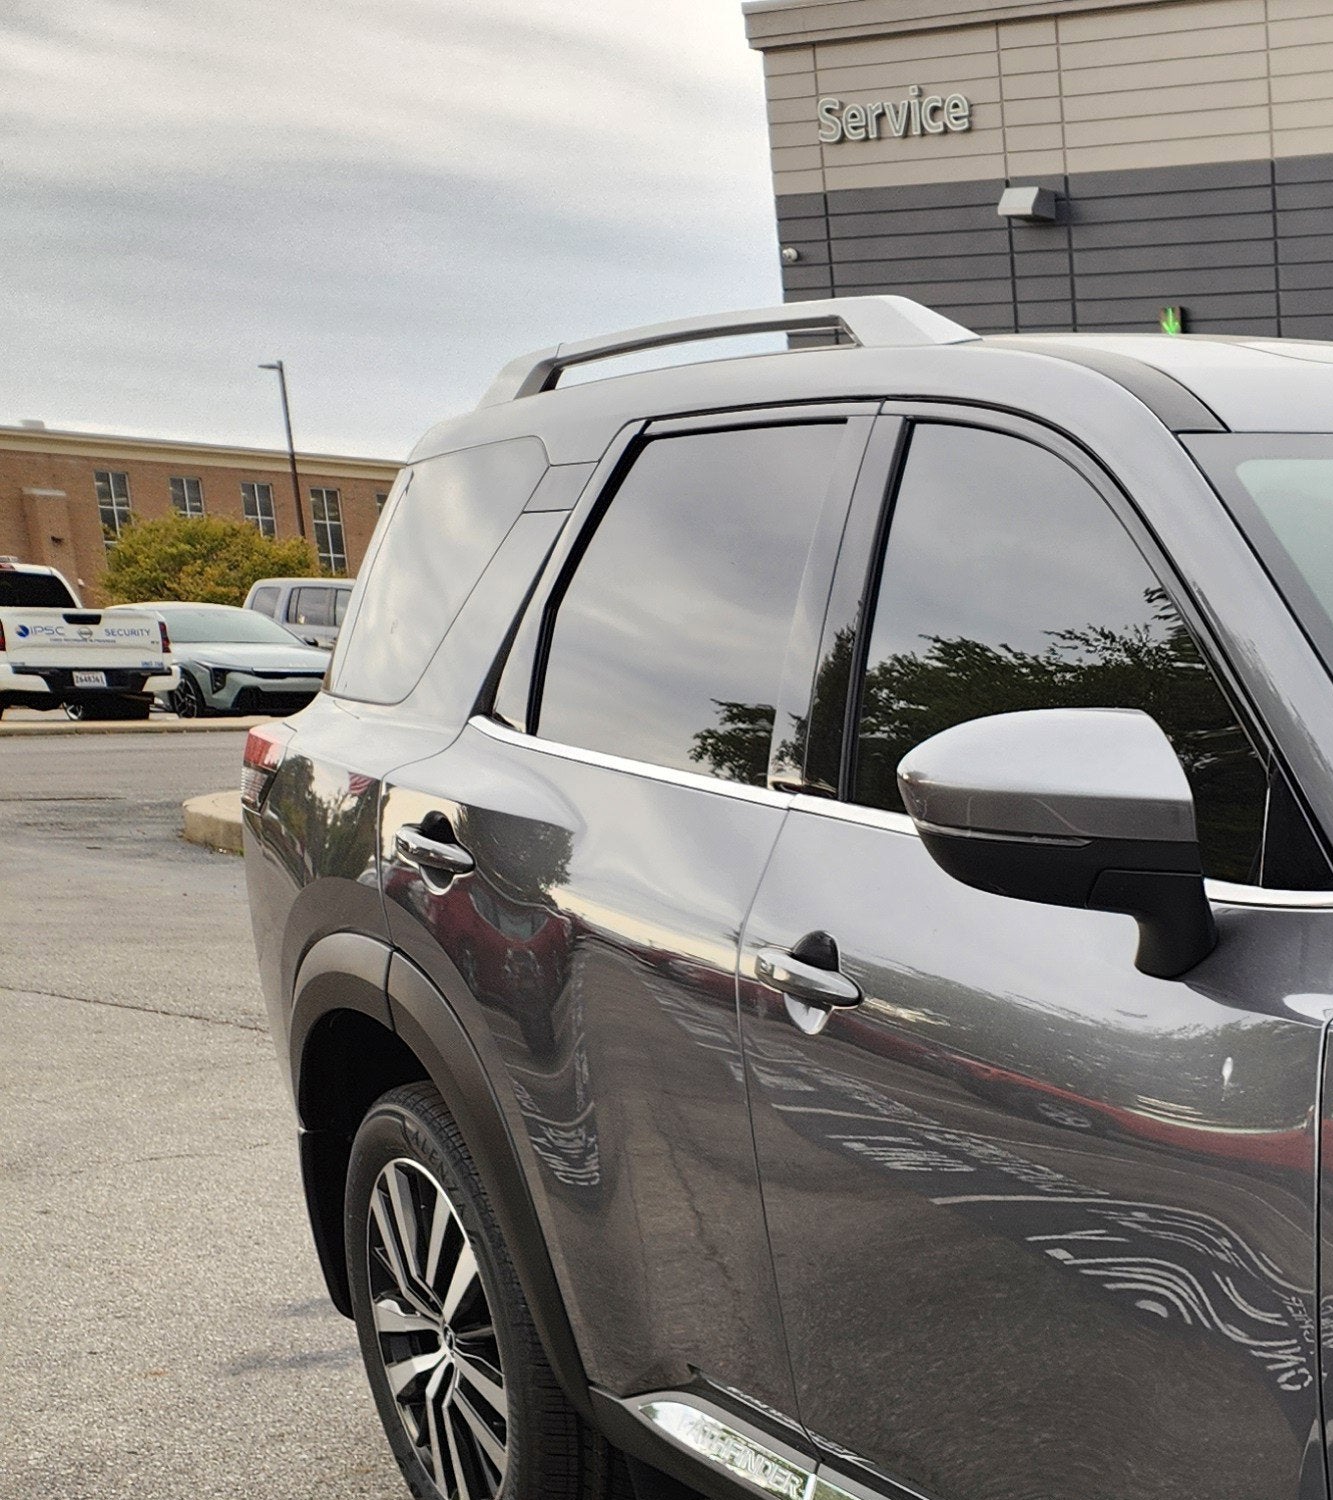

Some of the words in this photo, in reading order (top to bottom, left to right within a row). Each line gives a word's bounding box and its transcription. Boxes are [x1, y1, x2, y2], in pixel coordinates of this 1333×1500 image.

[818, 85, 970, 142] Service
[31, 625, 65, 636] IPSC
[105, 628, 150, 637] SECURITY
